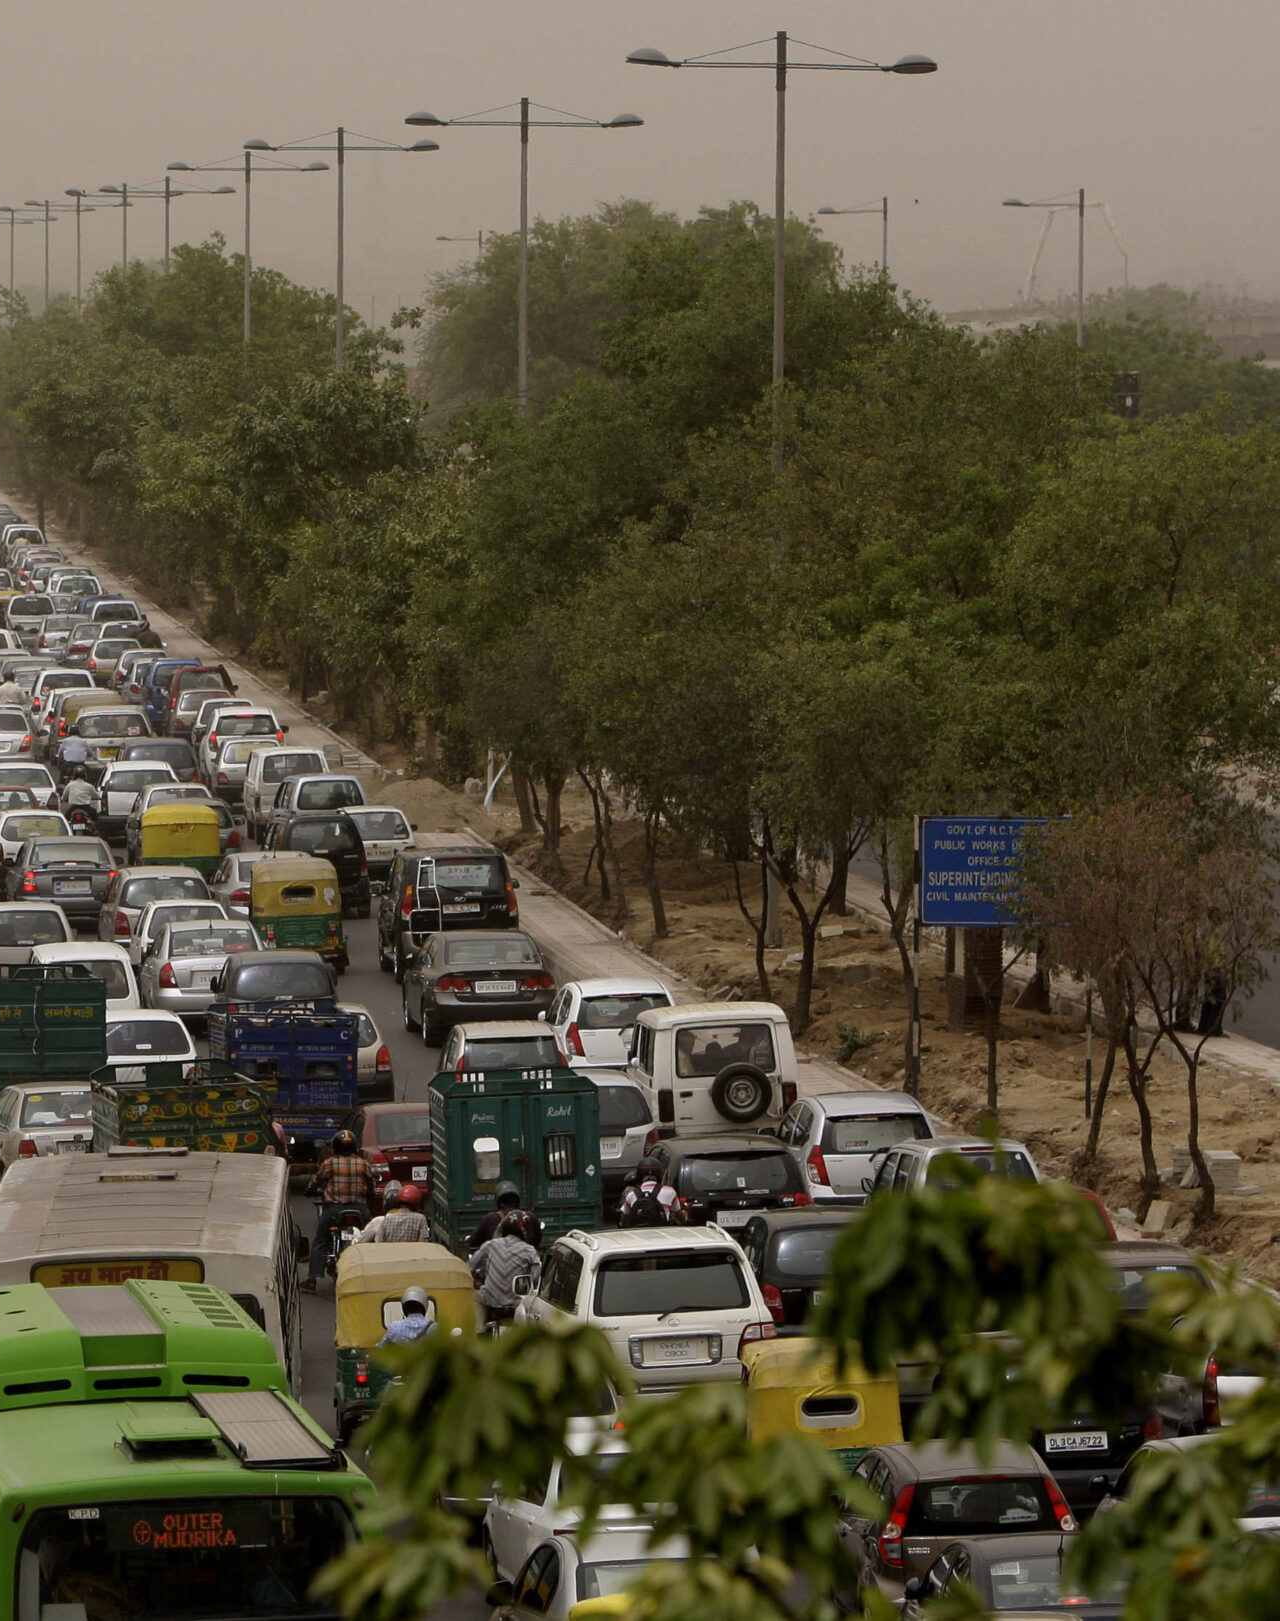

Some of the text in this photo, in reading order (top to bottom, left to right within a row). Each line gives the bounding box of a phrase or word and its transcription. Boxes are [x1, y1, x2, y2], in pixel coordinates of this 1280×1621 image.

[947, 825, 973, 835] GOVT.
[974, 825, 987, 835] OF
[934, 841, 966, 850] PUBLIC
[972, 841, 1006, 851] WORKS
[967, 856, 1000, 866] OFFICE
[926, 892, 950, 902] CIVIL
[234, 1028, 243, 1039] P
[546, 1106, 571, 1118] Rohit
[273, 1117, 310, 1125] PIAGGIO
[60, 1267, 93, 1285] जय
[146, 1261, 170, 1281] दी
[1050, 1438, 1060, 1448] DL
[163, 1513, 223, 1531] OUTER
[152, 1529, 237, 1548] MUDRIKA
